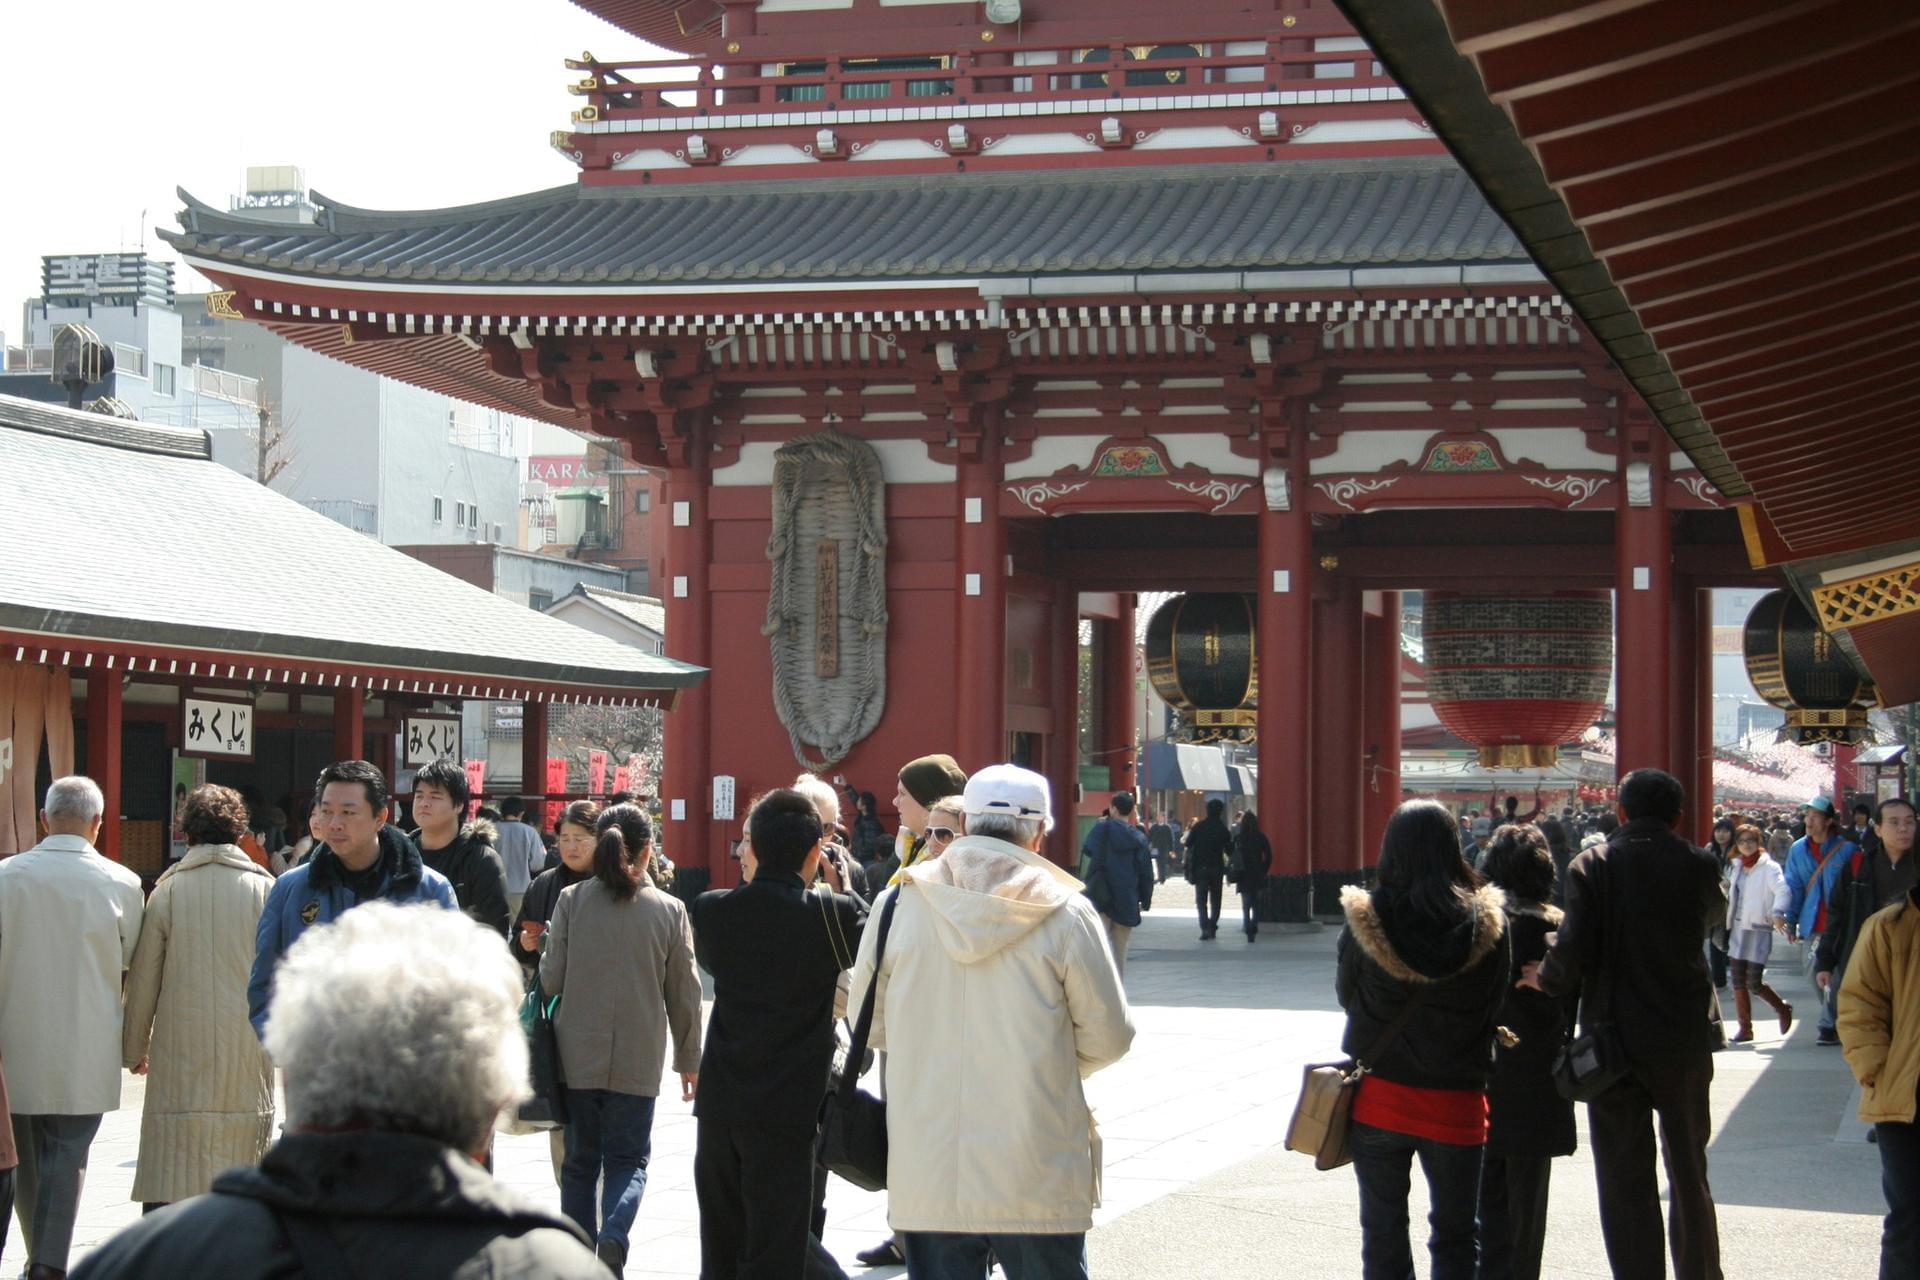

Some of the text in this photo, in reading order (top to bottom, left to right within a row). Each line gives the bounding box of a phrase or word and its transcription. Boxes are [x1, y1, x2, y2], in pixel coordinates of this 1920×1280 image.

[530, 463, 595, 478] KARA
[189, 707, 246, 744] みくじ
[410, 725, 455, 756] みくじ
